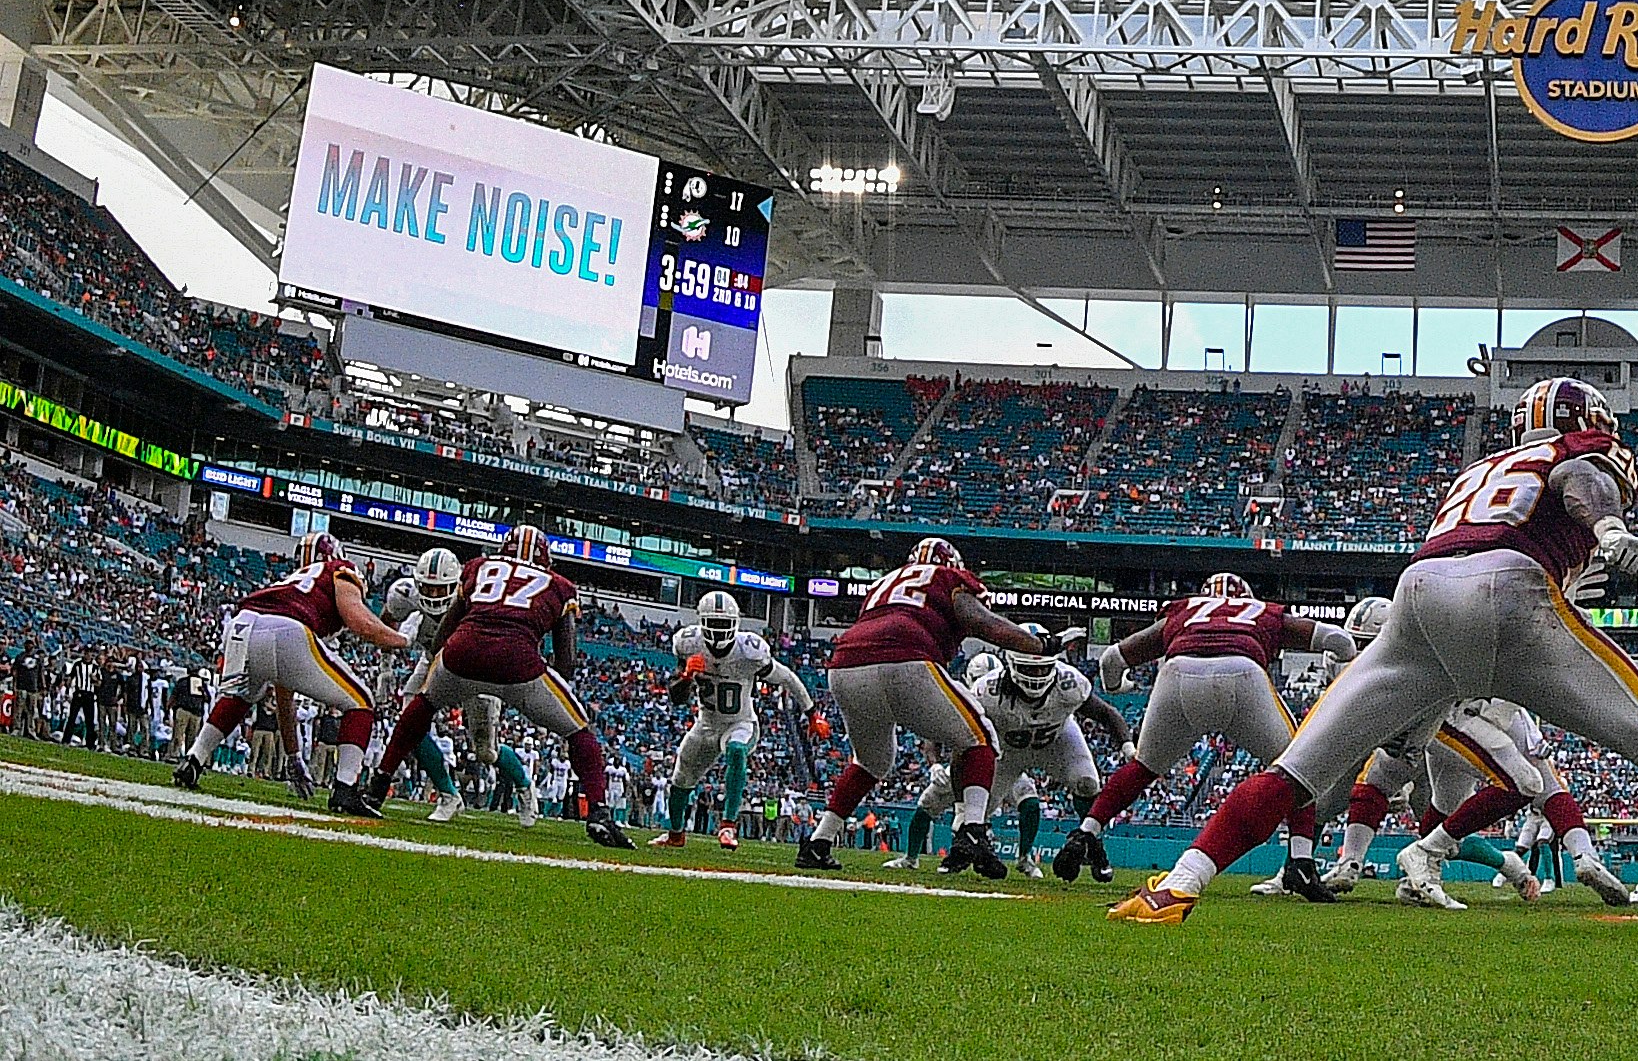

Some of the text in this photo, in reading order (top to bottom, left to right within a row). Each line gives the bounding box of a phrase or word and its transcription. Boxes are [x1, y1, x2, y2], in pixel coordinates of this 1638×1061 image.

[1450, 0, 1598, 55] Hard
[730, 191, 744, 211] 17
[317, 142, 625, 287] MAKE NOISE!
[725, 226, 740, 247] 10
[659, 254, 711, 300] 3:59
[712, 287, 732, 305] 2ND
[744, 294, 756, 311] 10
[653, 358, 733, 389] Hotels.com
[399, 437, 416, 450] VII
[204, 468, 259, 489] BUD LIGHT
[471, 452, 500, 468] 1972
[612, 480, 637, 496] 17-0
[1426, 443, 1558, 541] 26
[367, 507, 388, 520] 4TH
[455, 516, 496, 532] FALCONS
[1399, 541, 1415, 554] 75
[470, 560, 553, 609] 87
[741, 571, 787, 589] BUD LIGHT
[866, 564, 937, 611] 72
[1021, 592, 1087, 609] OFFICIAL
[1091, 597, 1158, 612] PARTNER
[1184, 597, 1266, 628] 77
[1290, 605, 1346, 620] LPHINS
[699, 679, 743, 715] 20
